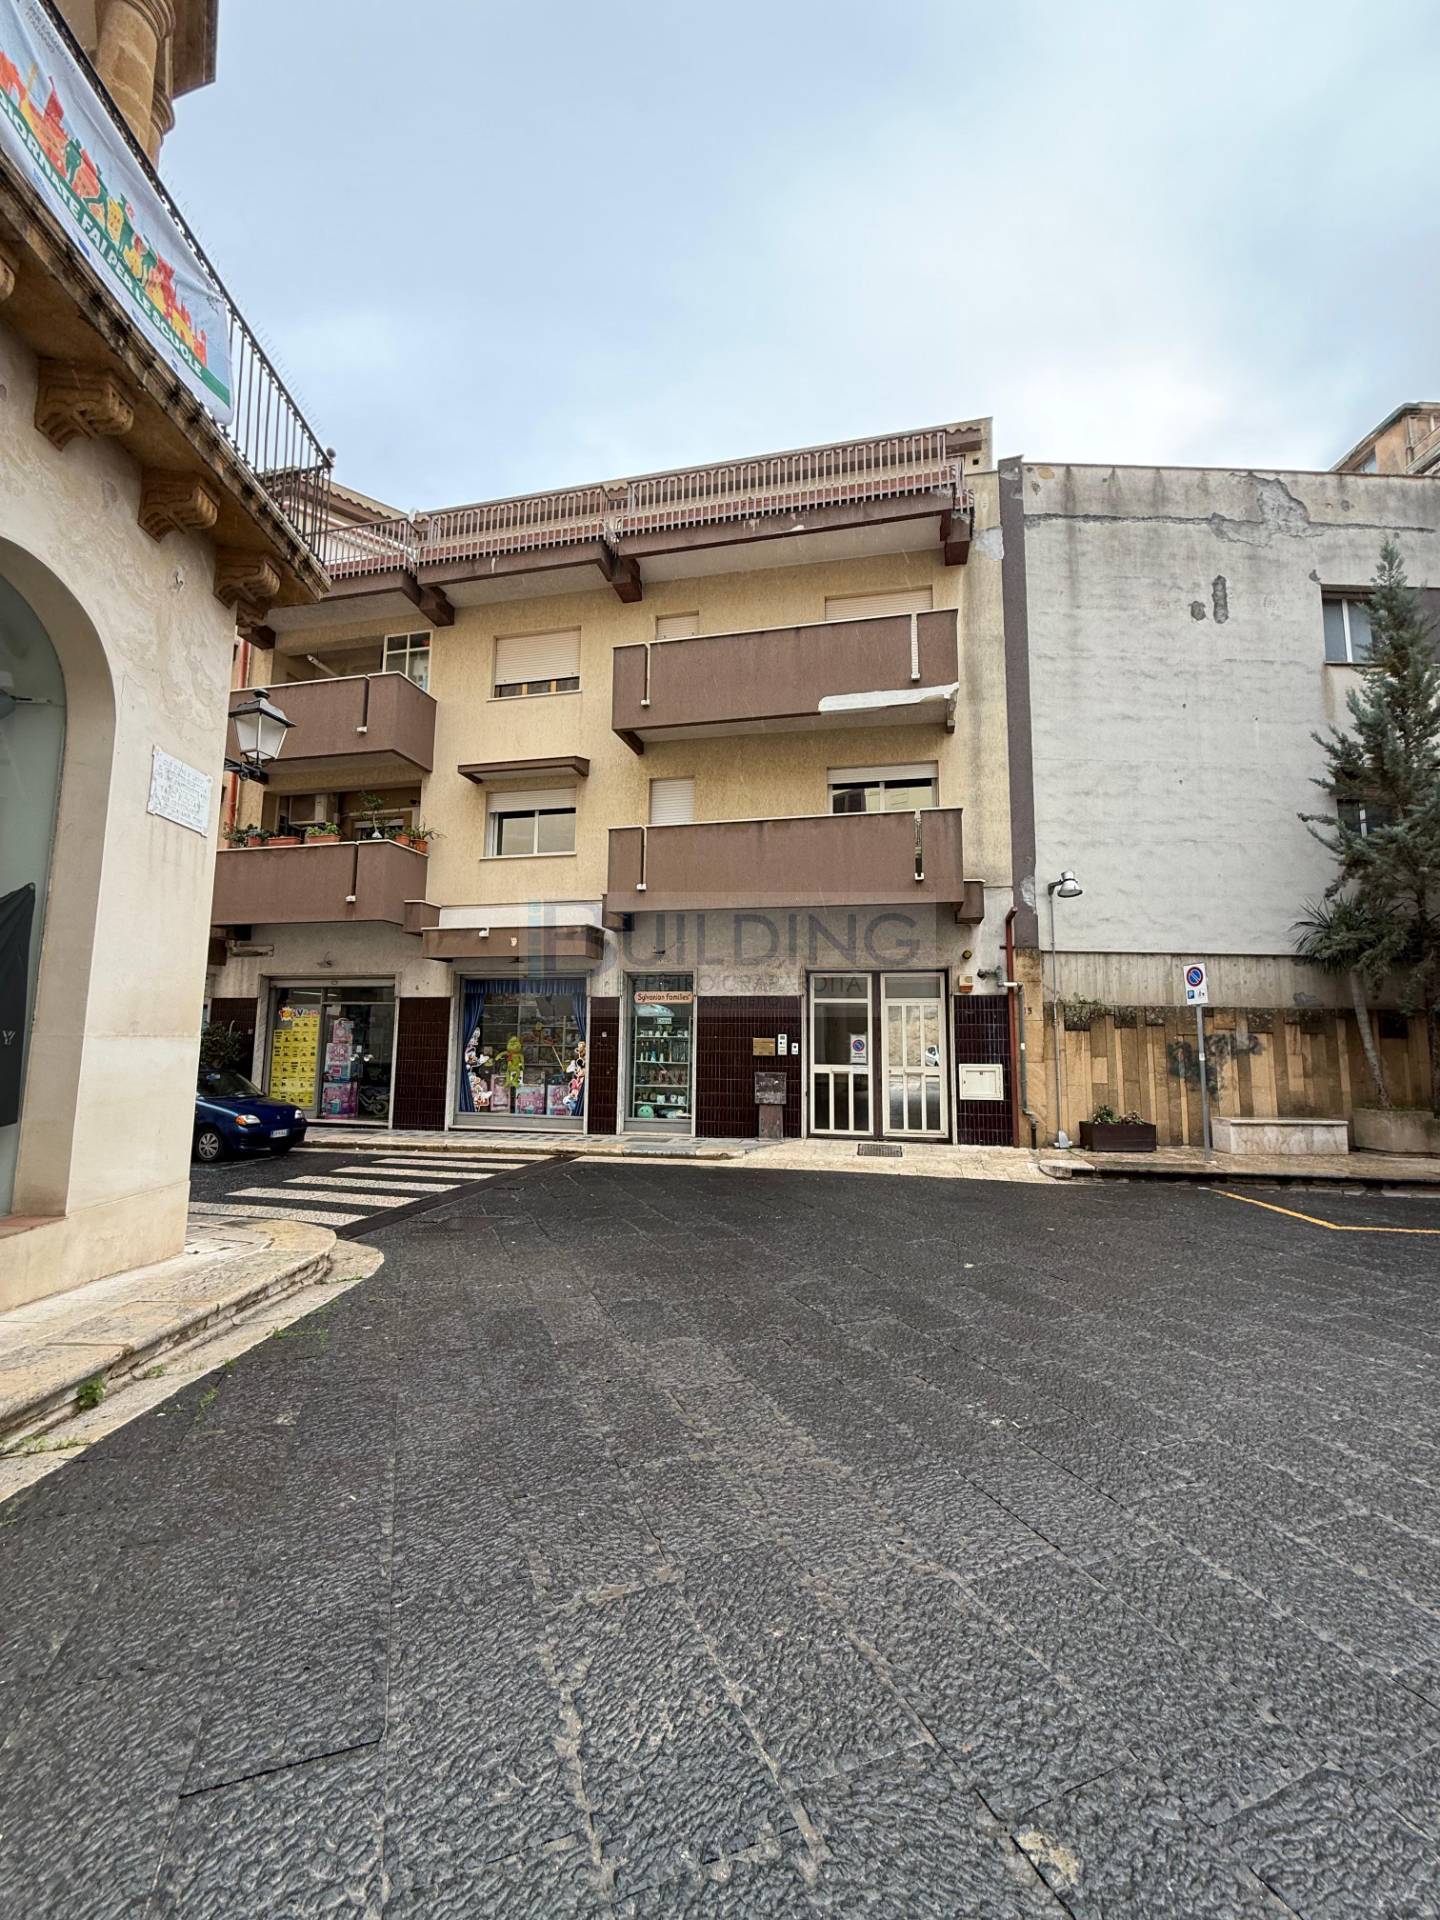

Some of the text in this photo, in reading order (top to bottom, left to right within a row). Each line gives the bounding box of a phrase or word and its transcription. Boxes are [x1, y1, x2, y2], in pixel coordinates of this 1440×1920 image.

[81, 214, 108, 256] FAI
[107, 252, 133, 293] PER
[134, 289, 151, 315] LE
[152, 312, 202, 378] SCUOLE
